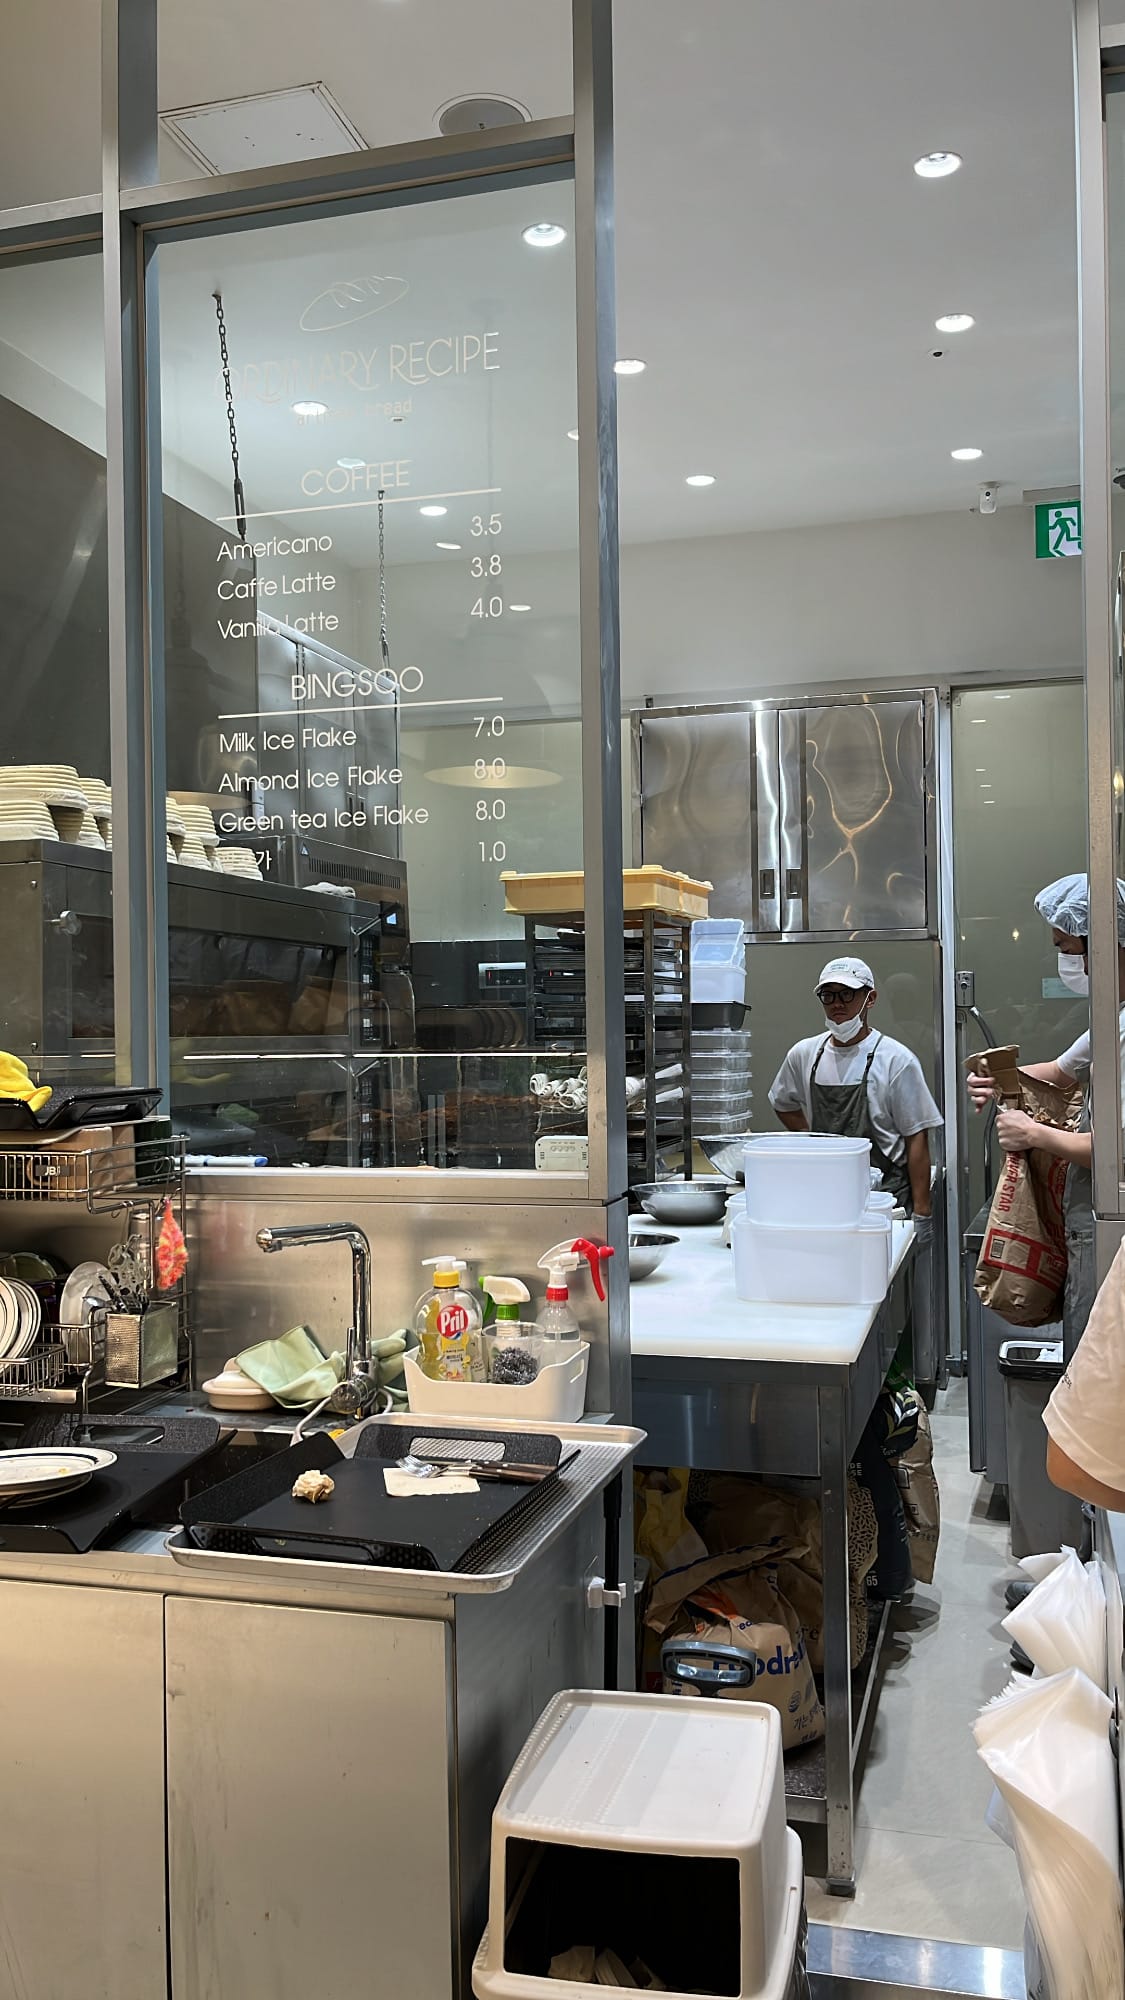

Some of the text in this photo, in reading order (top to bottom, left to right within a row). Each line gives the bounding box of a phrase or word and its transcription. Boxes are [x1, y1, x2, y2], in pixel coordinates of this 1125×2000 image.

[390, 332, 500, 385] RECIPE
[301, 460, 412, 496] COFFEE
[470, 513, 502, 537] 3.5
[216, 535, 333, 561] Americano
[470, 554, 502, 578] 3.8
[217, 571, 337, 601] Caffe Latte
[470, 596, 503, 618] 4.0
[217, 611, 340, 640] Vanilla Latte
[291, 666, 425, 701] BINGSOO
[473, 715, 506, 738] 7.0
[219, 727, 357, 753] Milk Ice Flake
[218, 766, 403, 793] Almond Ice Flake
[473, 757, 506, 781] 8.0
[219, 805, 429, 833] Green tea Ice Flake
[475, 799, 506, 821] 8.0
[478, 841, 506, 862] 1.0
[998, 1184, 1016, 1213] STAR
[440, 1310, 464, 1333] Pril
